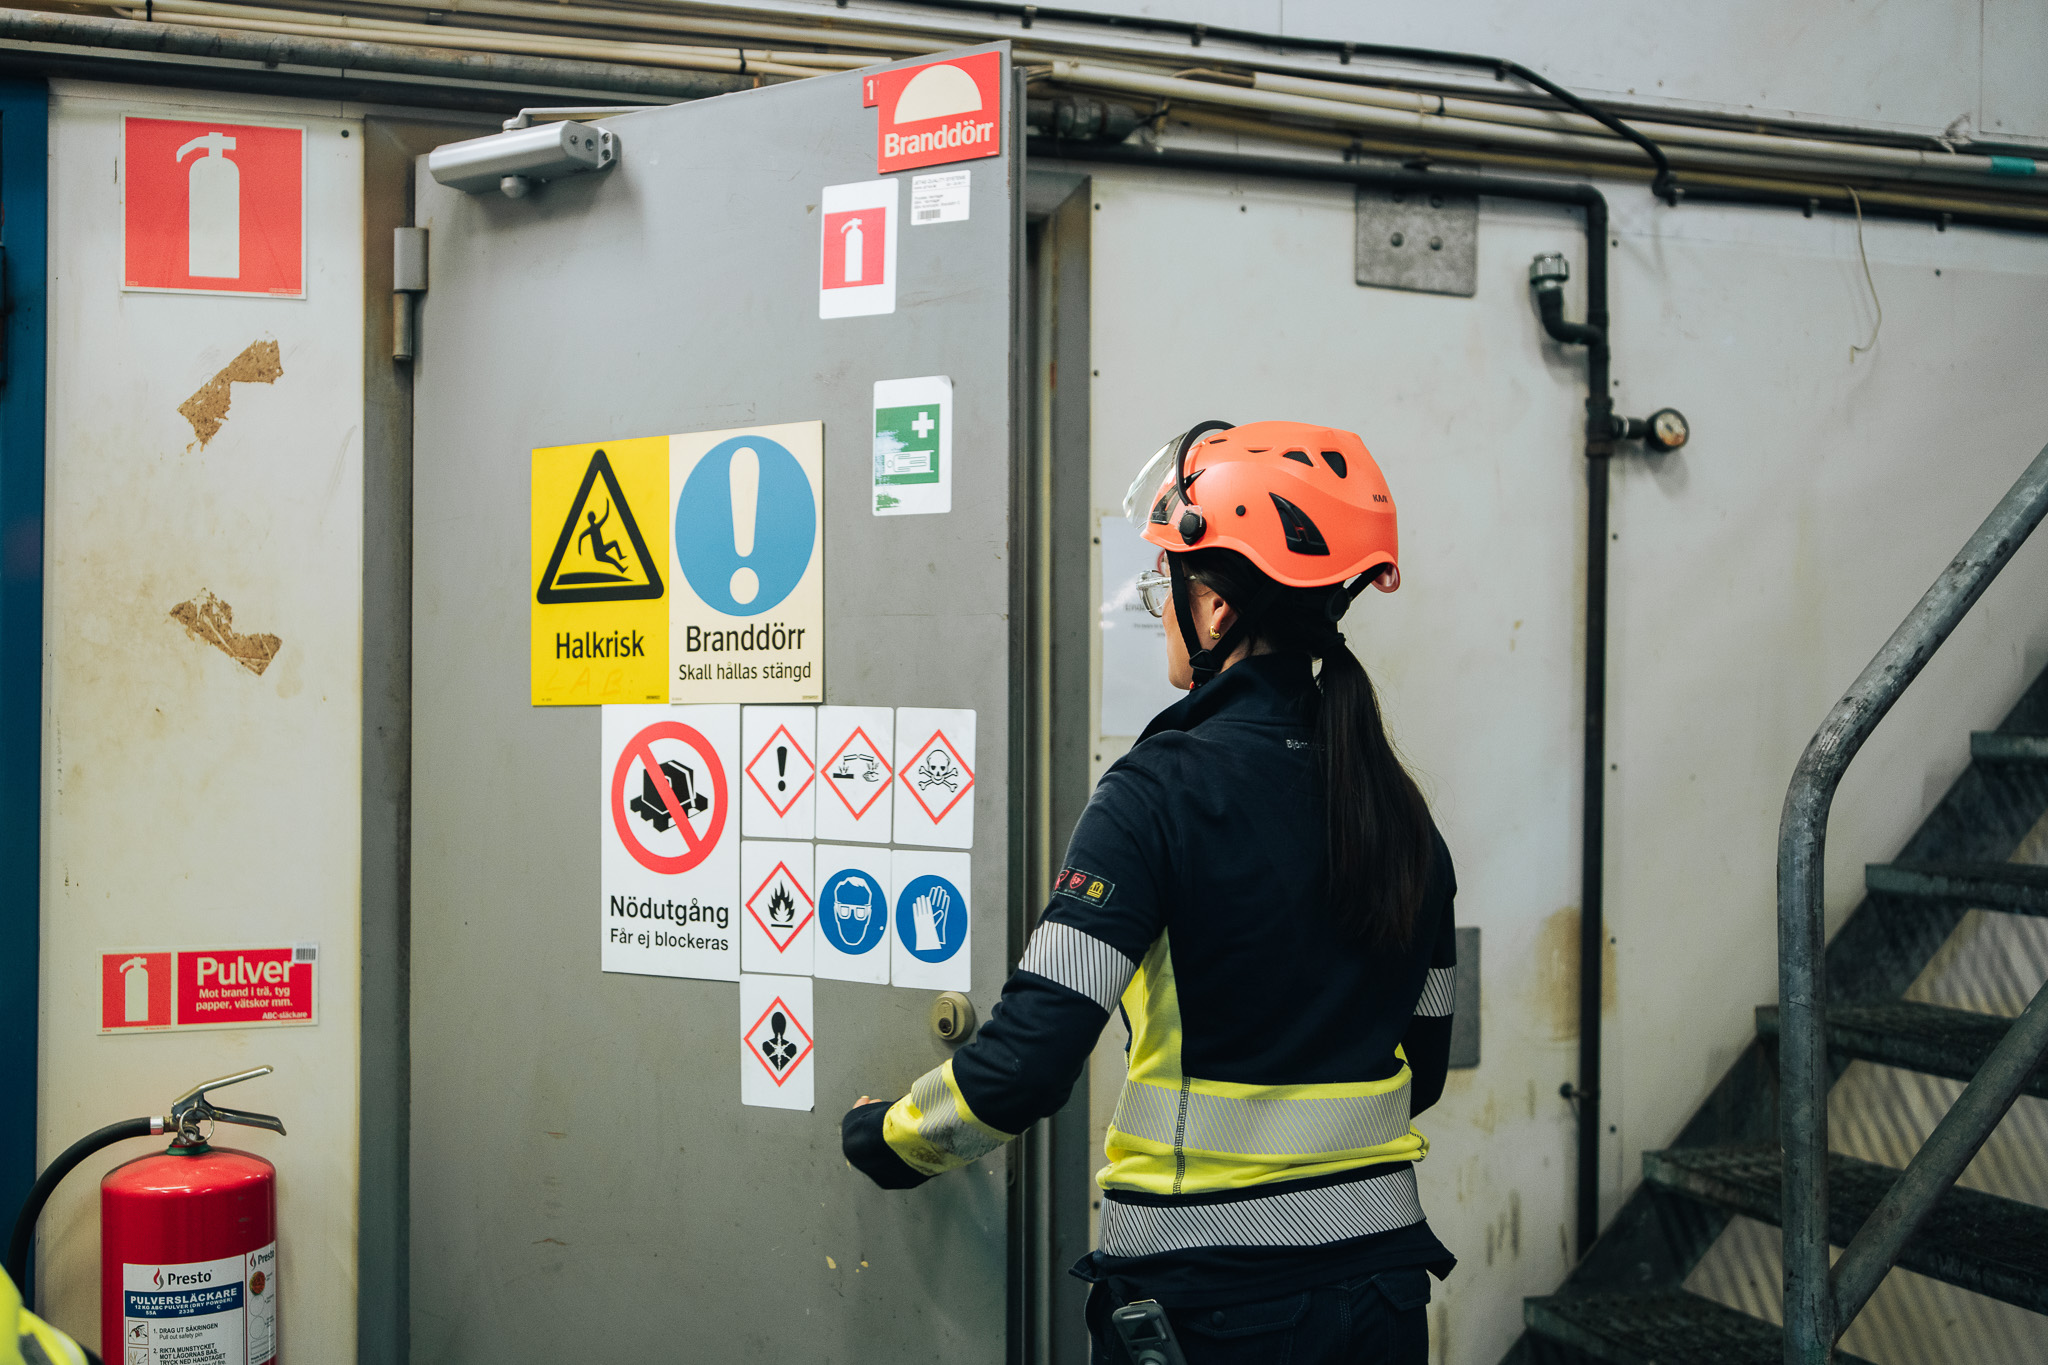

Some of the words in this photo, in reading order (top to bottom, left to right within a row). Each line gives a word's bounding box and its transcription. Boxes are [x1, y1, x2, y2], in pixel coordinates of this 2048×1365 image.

[885, 119, 994, 158] Branddörr
[556, 629, 645, 659] Halkrisk
[686, 622, 806, 652] Branddörr
[679, 663, 712, 680] Skall
[717, 661, 757, 680] hållas
[763, 661, 811, 682] stängd
[611, 895, 729, 929] Nödutgång
[611, 927, 633, 944] Får
[638, 930, 650, 949] ej
[655, 931, 729, 951] blockeras
[197, 955, 295, 986] Pulver
[199, 988, 219, 999] Mot
[221, 987, 248, 998] brand
[250, 986, 254, 996] i
[275, 986, 290, 998] tyg
[196, 1000, 232, 1012] papper,
[235, 998, 269, 1009] vätskor
[272, 998, 293, 1007] mm.
[262, 1011, 308, 1020] ABC-släckare
[168, 1271, 212, 1286] Presto
[130, 1287, 237, 1305] PULVERSLÄCKARE
[206, 1297, 233, 1306] POWDER)
[185, 1322, 219, 1333] SÄKRINGEN
[178, 1331, 194, 1340] safety
[159, 1352, 172, 1360] MOT
[172, 1350, 205, 1359] LÅGORNAS
[176, 1342, 216, 1354] MUNSTYCKET
[192, 1353, 227, 1363] HANDTAGET
